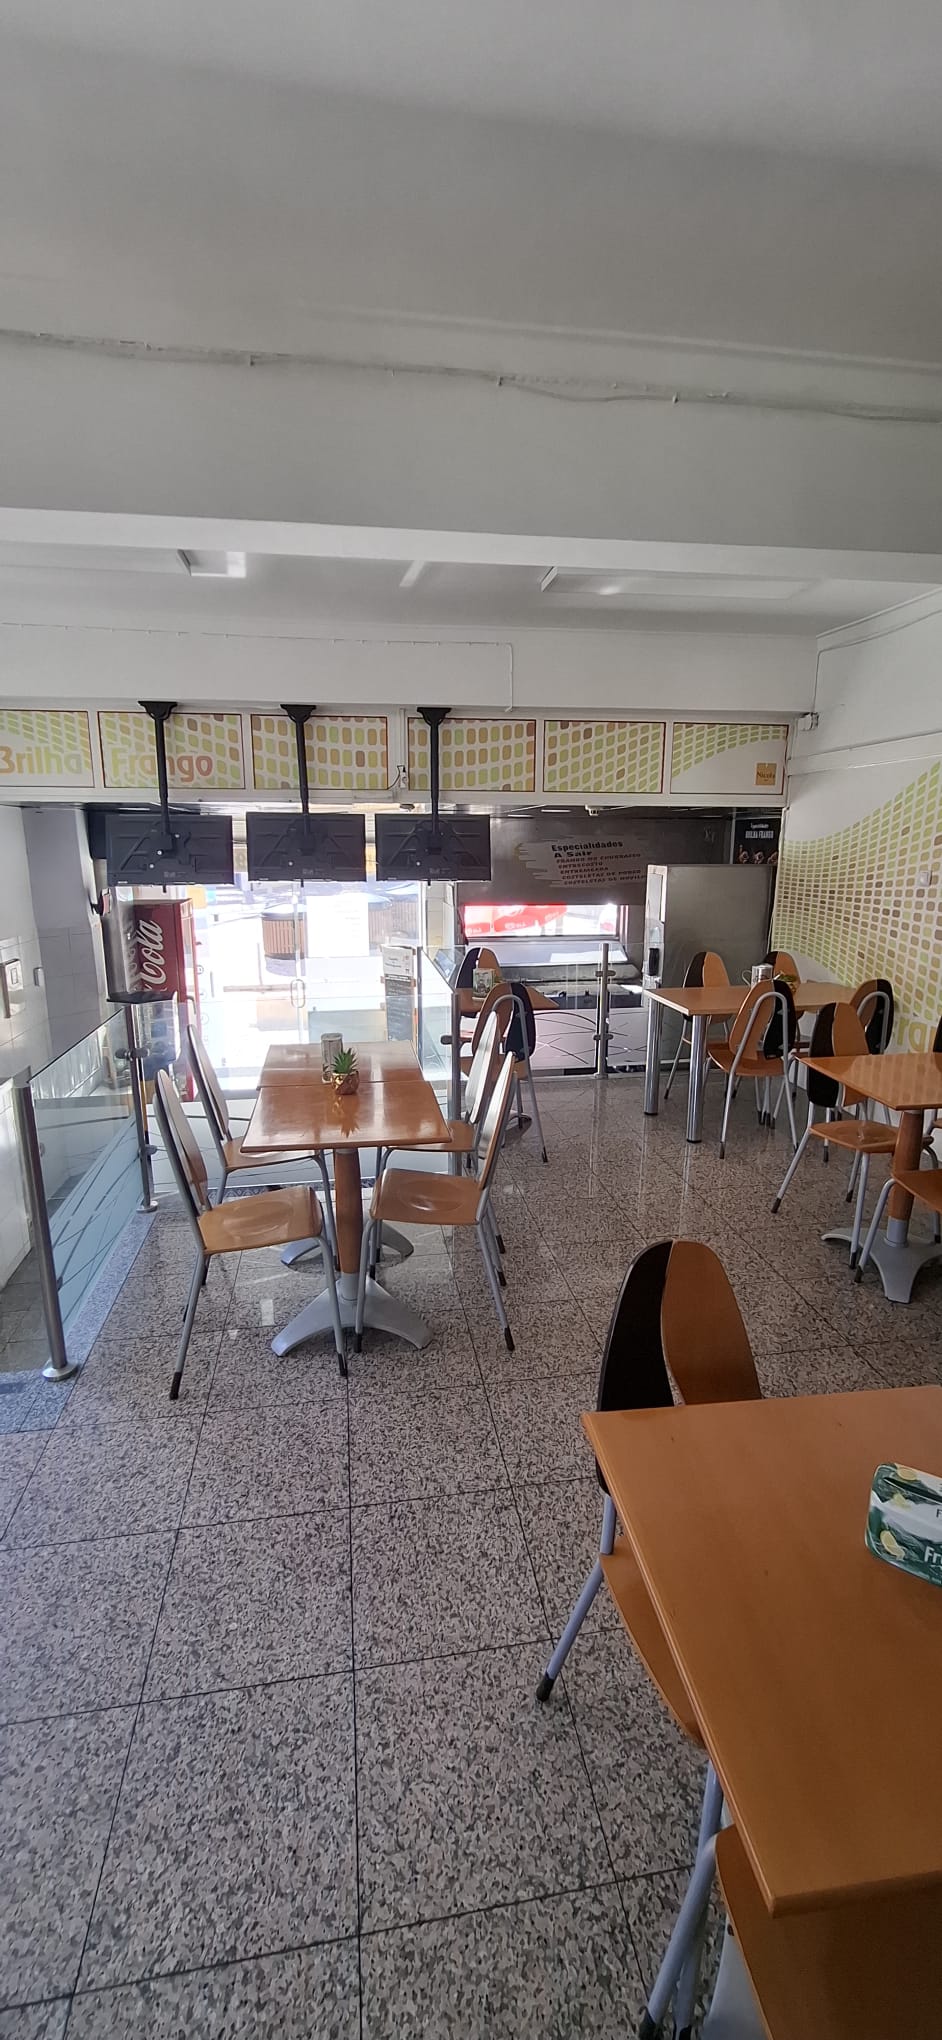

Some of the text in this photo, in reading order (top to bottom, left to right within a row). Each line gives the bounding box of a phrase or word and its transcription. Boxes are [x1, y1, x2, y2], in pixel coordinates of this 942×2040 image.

[0, 745, 214, 783] Brilha Frango
[551, 841, 623, 852] Especialidades
[137, 920, 166, 984] Cola
